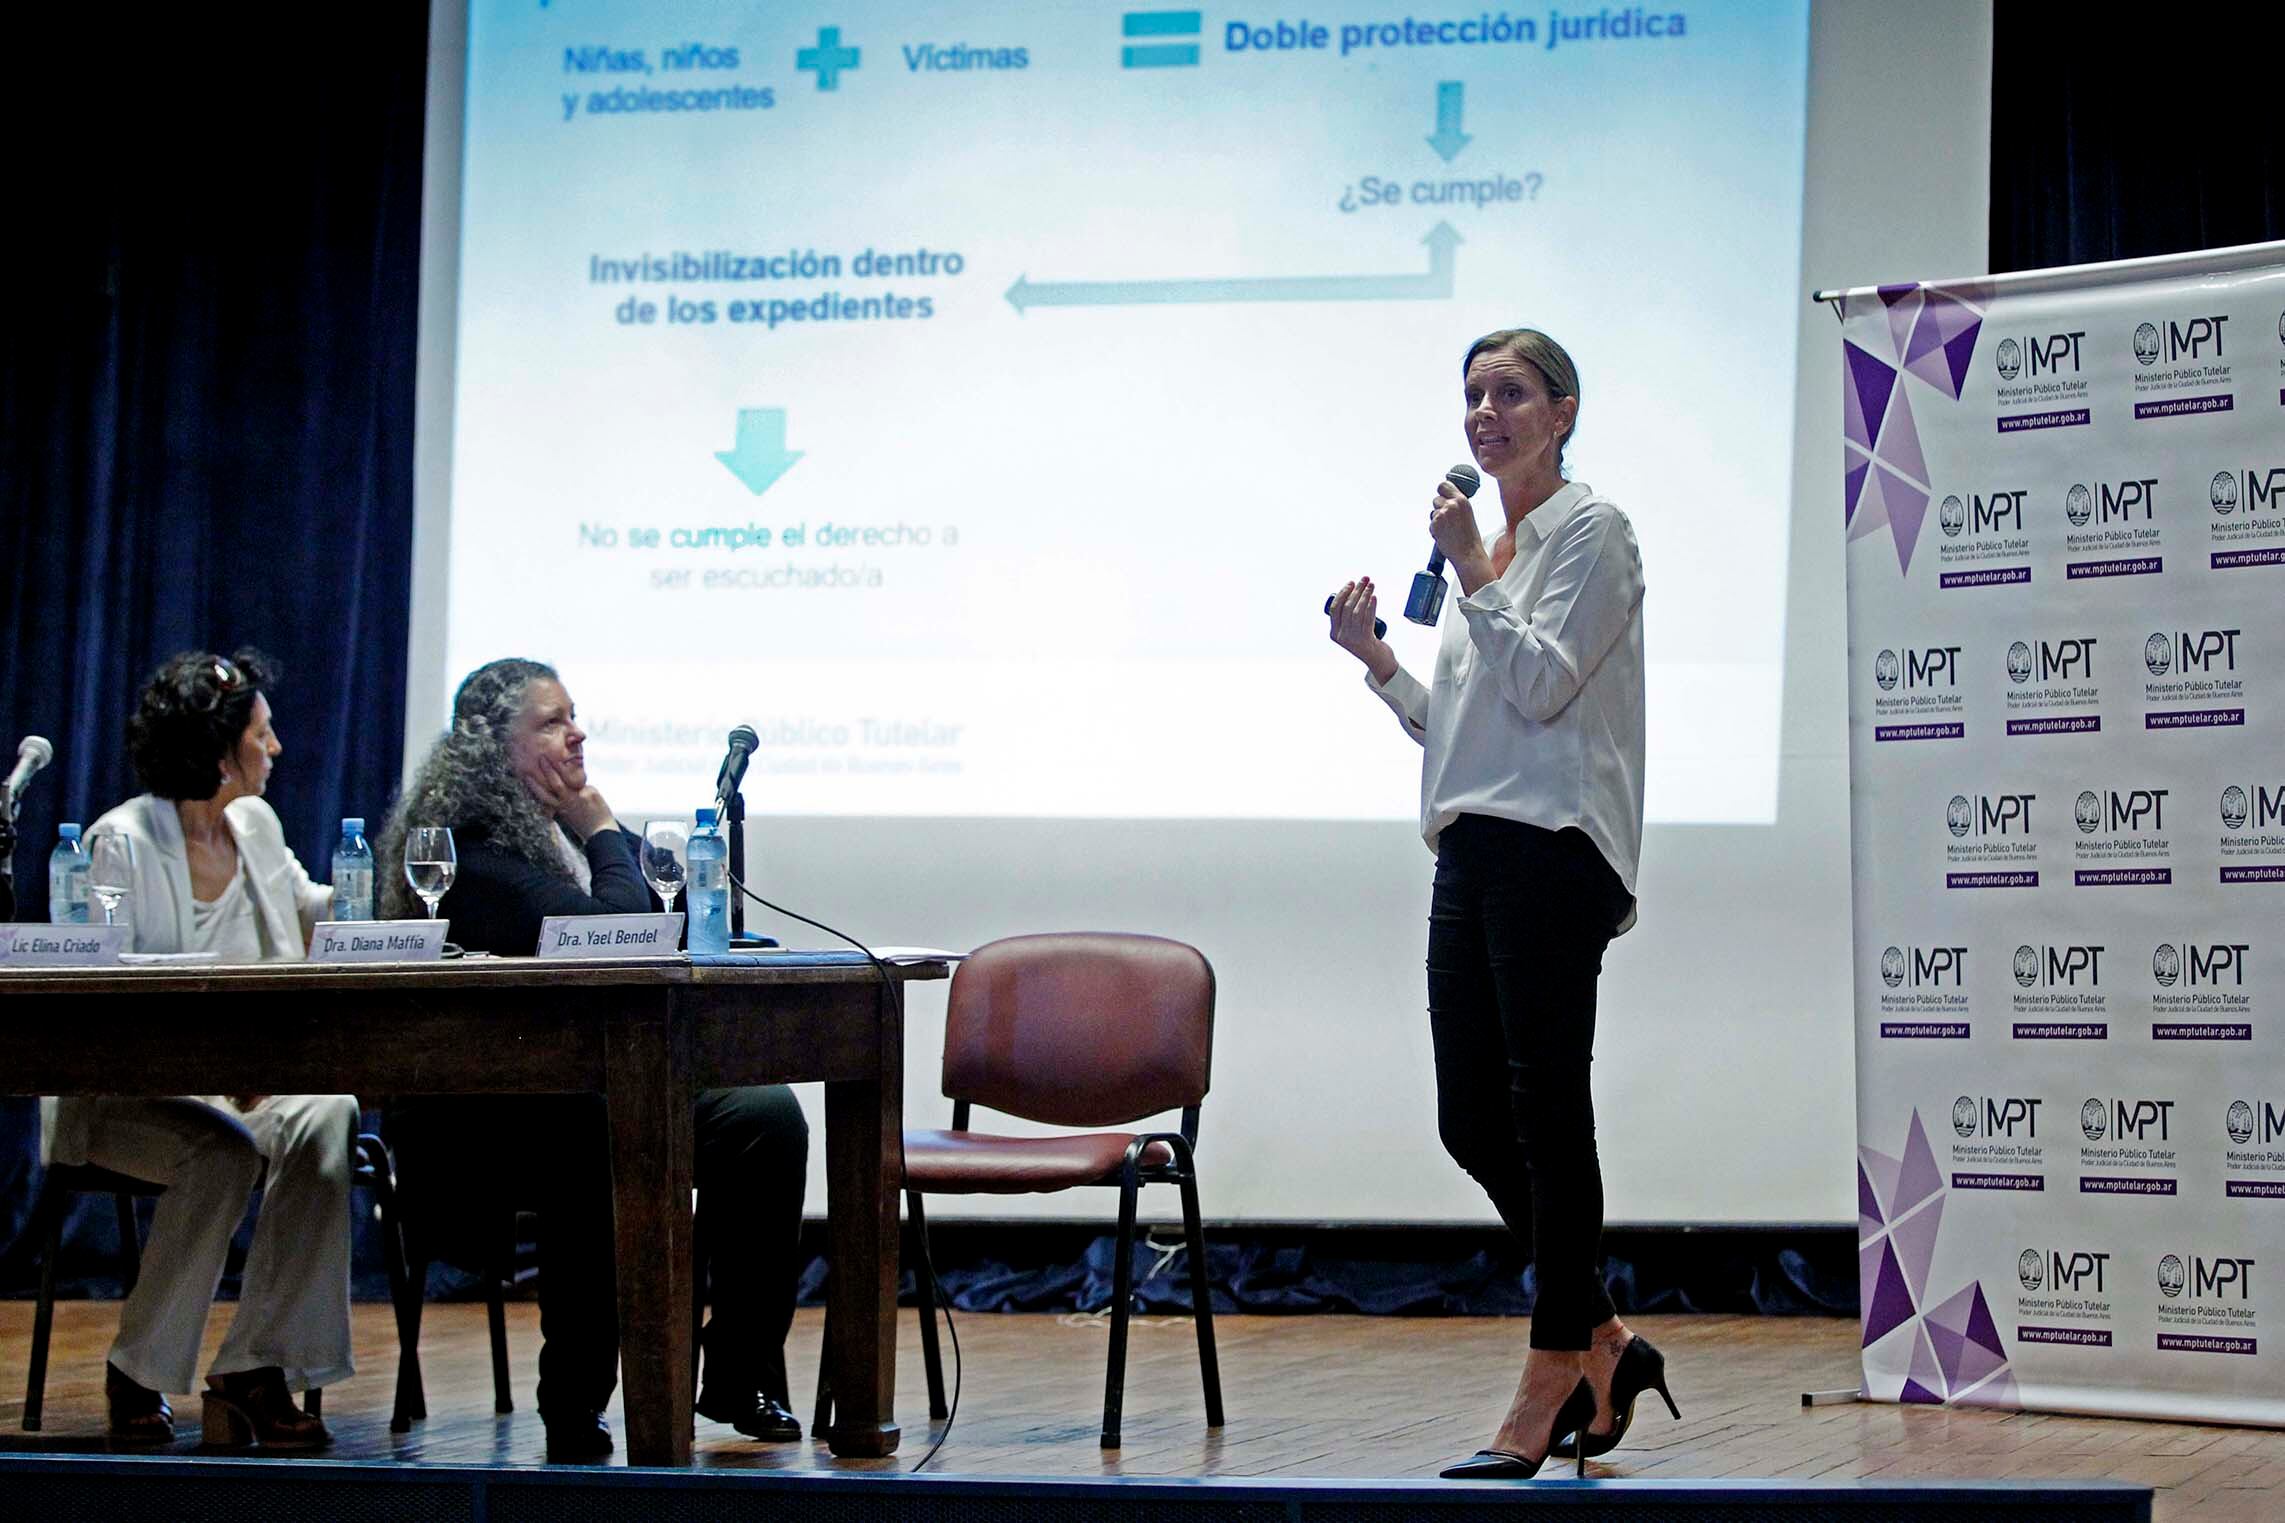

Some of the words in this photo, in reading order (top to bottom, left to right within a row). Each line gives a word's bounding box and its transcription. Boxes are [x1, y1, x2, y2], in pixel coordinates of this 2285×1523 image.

[1225, 20, 1329, 54] Doble
[1340, 15, 1537, 56] protección
[1544, 7, 1687, 50] jurídica
[564, 43, 653, 76] Niñas,
[661, 42, 740, 72] niños
[903, 43, 1030, 73] Víctimas
[561, 89, 579, 120] y
[586, 83, 775, 115] adolescentes
[1338, 178, 1401, 213] ¿Se
[1410, 172, 1544, 209] cumple?
[589, 250, 842, 284] Invisibilización
[851, 248, 964, 278] dentro
[615, 295, 657, 326] de
[667, 292, 718, 324] los
[728, 290, 934, 329] expedientes
[2171, 316, 2228, 360] MPT
[2031, 332, 2085, 376] MPT
[2135, 371, 2172, 383] Ministerio
[2174, 369, 2202, 380] Público
[2204, 366, 2230, 376] Tutelar
[1997, 386, 2032, 398] Ministerio
[2034, 384, 2060, 394] Público
[2062, 380, 2087, 391] Tutelar
[2140, 399, 2229, 414] www.mptutelar.gob.ar
[2001, 413, 2086, 428] www.mptutelar.gob.ar
[2249, 468, 2285, 511] MP
[2102, 479, 2158, 522] MPT
[1975, 491, 2027, 533] MPT
[2211, 521, 2250, 533] Ministerio
[2251, 519, 2281, 530] Público
[578, 521, 619, 549] No
[628, 527, 661, 549] se
[669, 521, 772, 551] cumple
[782, 521, 806, 548] el
[815, 521, 932, 548] derecho
[942, 525, 960, 547] a
[2067, 532, 2103, 544] Ministerio
[2105, 531, 2132, 541] Público
[2134, 528, 2160, 539] Tutelar
[1940, 543, 1975, 554] Ministerio
[1976, 541, 2002, 551] Público
[2004, 539, 2029, 549] Tutelar
[2071, 561, 2158, 575] www.mptutelar.gob.ar
[650, 566, 691, 589] ser
[1944, 571, 2027, 585] www.mptutelar.gob.ar
[2183, 630, 2240, 672] MPT
[1909, 647, 1961, 687] MPT
[2042, 639, 2096, 680] MPT
[2145, 682, 2183, 693] Ministerio
[2185, 681, 2213, 691] Público
[2215, 679, 2242, 690] Tutelar
[1876, 697, 1910, 708] Ministerio
[1911, 696, 1936, 706] Público
[1938, 694, 1962, 704] Tutelar
[2007, 690, 2043, 701] Ministerio
[2044, 689, 2071, 699] Público
[2073, 687, 2098, 697] Tutelar
[2011, 719, 2097, 732] www.mptutelar.gob.ar
[2150, 712, 2240, 726] www.mptutelar.gob.ar
[1880, 726, 1960, 739] www.mptutelar.gob.ar
[1982, 795, 2035, 834] MPT
[2112, 790, 2168, 831] MPT
[1947, 844, 1982, 854] Ministerio
[1984, 843, 2010, 853] Público
[2012, 843, 2037, 852] Tutelar
[2075, 840, 2112, 850] Ministerio
[2114, 840, 2141, 849] Público
[2143, 839, 2170, 849] Tutelar
[2220, 836, 2259, 847] Ministerio
[2261, 835, 2285, 846] Públic
[1951, 874, 2035, 886] www.mptutelar.gob.ar
[2079, 871, 2168, 883] www.mptutelar.gob.ar
[2224, 867, 2285, 880] www.mptutela
[324, 938, 347, 953] Dra.
[351, 936, 383, 951] Diana
[558, 931, 582, 947] Dra.
[586, 930, 612, 945] Yael
[615, 928, 658, 944] Bendel
[12, 939, 30, 953] Lic
[32, 938, 60, 953] Elina
[64, 938, 100, 953] Criado
[1915, 948, 1967, 985] MPT
[2049, 947, 2104, 985] MPT
[2191, 945, 2249, 985] MPT
[1882, 995, 1915, 1004] Ministerio
[1917, 994, 1942, 1004] Público
[1944, 995, 1968, 1004] Tutelar
[2014, 995, 2049, 1004] Ministerio
[2051, 995, 2078, 1004] Público
[2079, 995, 2105, 1004] Tutelar
[2153, 994, 2191, 1004] Ministerio
[2192, 994, 2221, 1004] Público
[2223, 994, 2250, 1004] Tutelar
[1885, 1025, 1966, 1036] www.mptutelar.gob.ar
[2017, 1027, 2103, 1038] www.mptutelar.gob.ar
[2157, 1027, 2247, 1038] www.mptutelar.gob.ar
[1988, 1099, 2041, 1137] MPT
[2118, 1101, 2174, 1140] MPT
[1953, 1145, 1988, 1155] Ministerio
[1989, 1145, 2015, 1155] Público
[2017, 1147, 2042, 1156] Tutelar
[2081, 1148, 2118, 1158] Ministerio
[2119, 1148, 2147, 1158] Público
[2149, 1150, 2175, 1159] Tutelar
[2226, 1151, 2266, 1161] Ministerio
[2267, 1151, 2285, 1162] Públ
[1956, 1177, 2040, 1189] www.mptutelar.gob.ar
[2084, 1181, 2173, 1193] www.mptutelar.gob.ar
[2054, 1252, 2110, 1292] MPT
[2196, 1258, 2255, 1299] MPT
[2019, 1298, 2055, 1308] Ministerio
[2056, 1299, 2083, 1310] Público
[2085, 1301, 2110, 1311] Tutelar
[2158, 1305, 2196, 1315] Ministerio
[2197, 1306, 2226, 1317] Público
[2228, 1308, 2255, 1318] Tutelar
[2022, 1331, 2108, 1344] www.mptutelar.gob.ar
[2162, 1338, 2252, 1351] www.mptutelar.gob.ar
